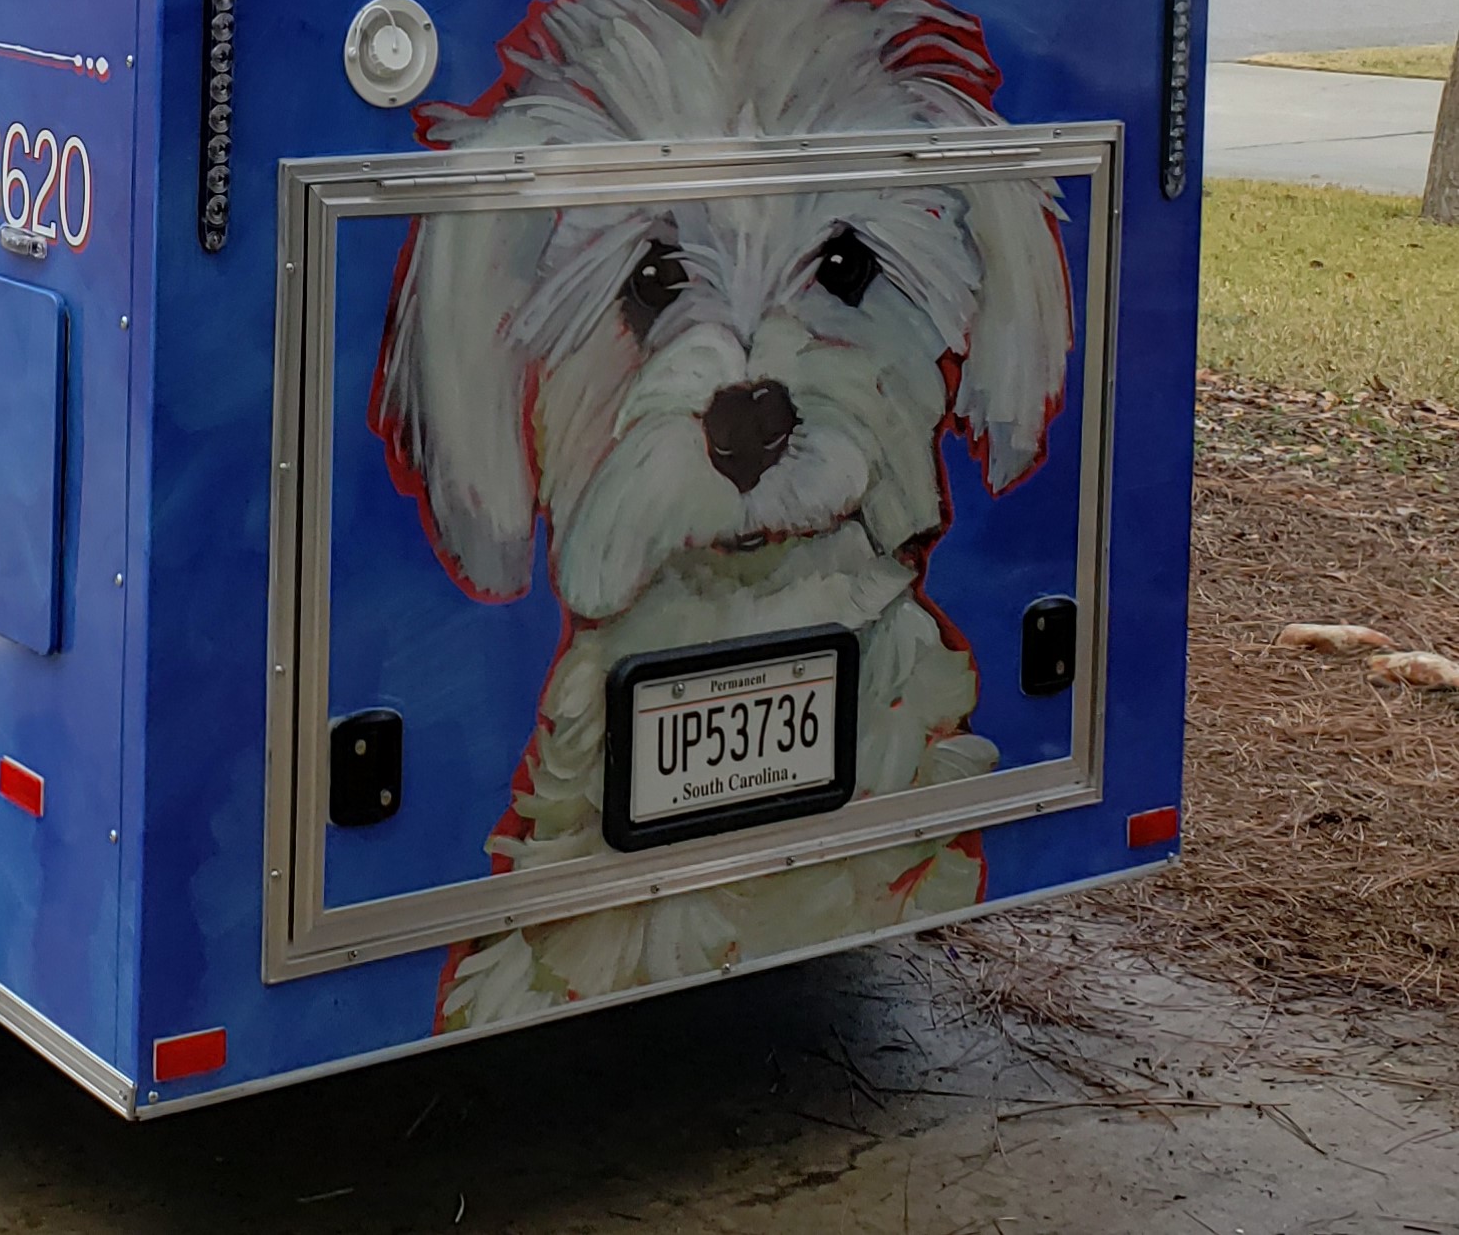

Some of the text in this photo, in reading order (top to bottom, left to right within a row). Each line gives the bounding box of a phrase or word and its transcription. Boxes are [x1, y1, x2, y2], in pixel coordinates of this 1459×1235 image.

[709, 672, 767, 693] Permanent
[657, 690, 819, 776] UP53736
[682, 766, 789, 801] South Carolina
